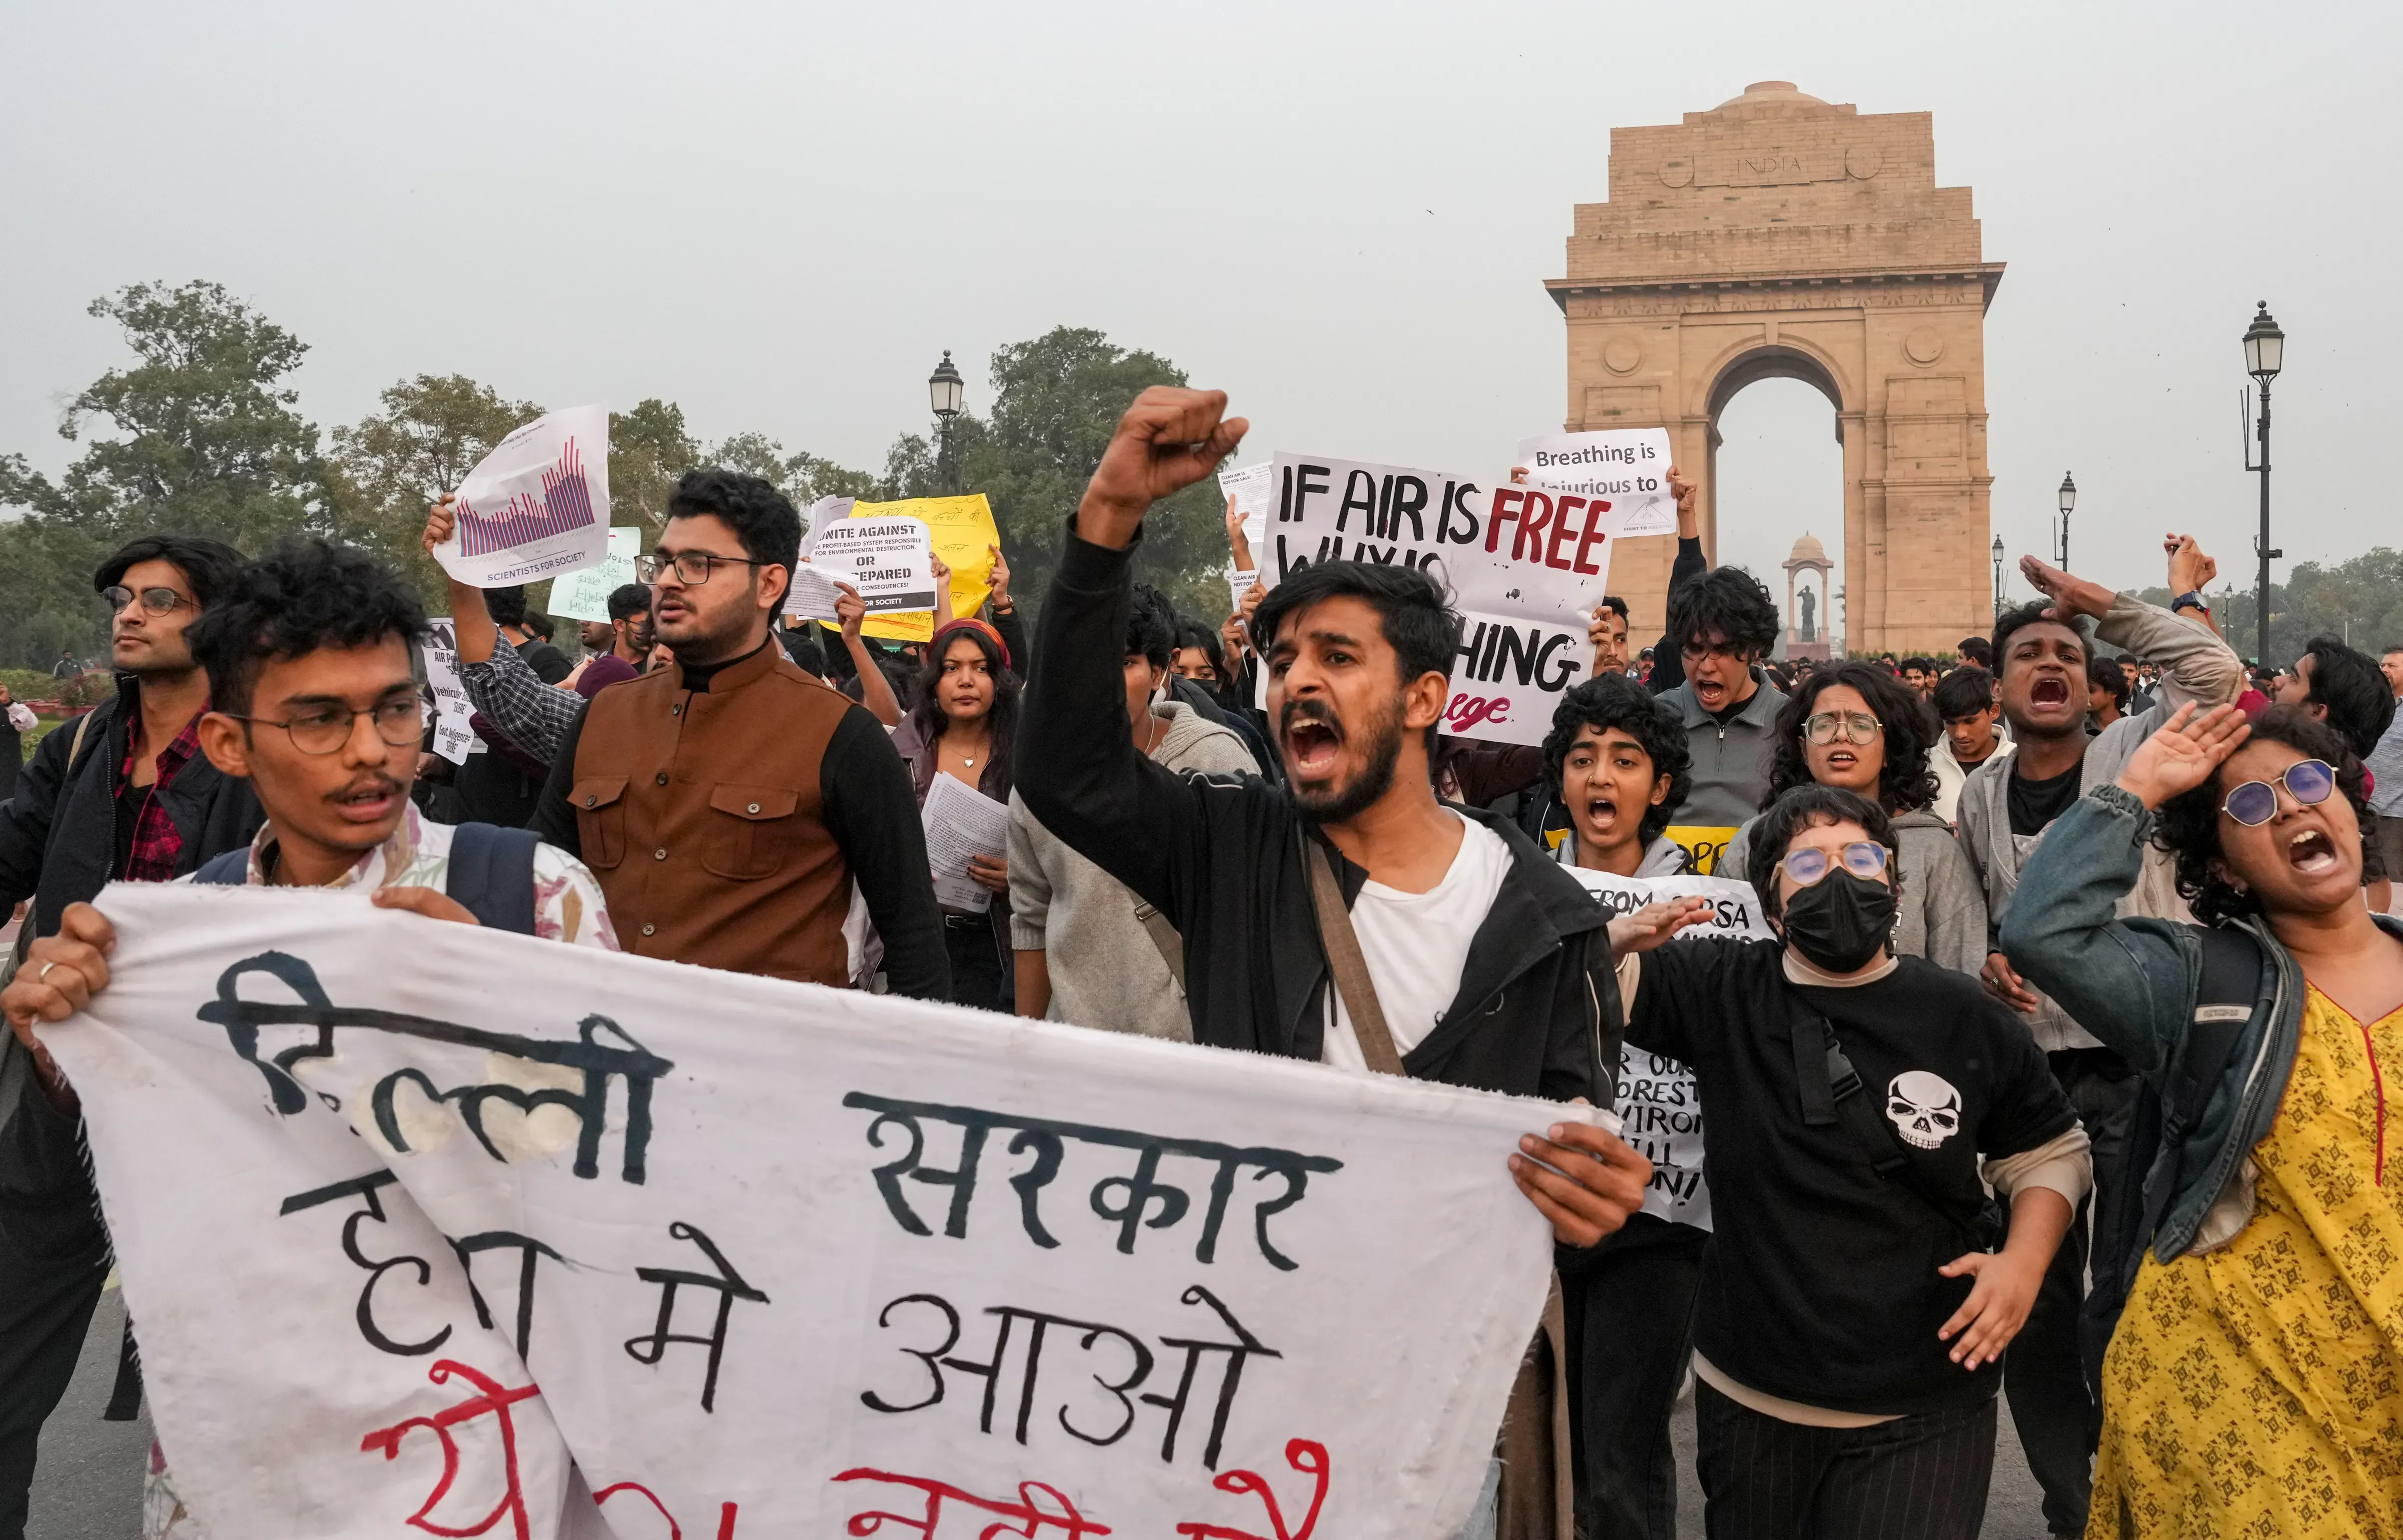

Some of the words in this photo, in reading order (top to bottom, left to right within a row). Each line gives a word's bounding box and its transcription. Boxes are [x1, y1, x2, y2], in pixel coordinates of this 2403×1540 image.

[1737, 157, 1801, 173] INDIA
[1536, 445, 1636, 466] Breathing
[1640, 442, 1656, 459] is
[1637, 476, 1658, 492] to
[1278, 464, 1330, 523] IF
[1336, 469, 1429, 542] AIR
[1436, 480, 1482, 545] IS
[1484, 487, 1612, 576] FREE
[859, 525, 916, 538] AGAINST
[829, 547, 874, 555] ENVIRONMENTAL
[488, 564, 540, 581] SCIENTISTS
[540, 560, 555, 571] FOR
[555, 551, 586, 567] SOCIETY
[856, 556, 875, 566] OR
[851, 568, 911, 582] EPARED
[862, 583, 909, 591] CONSEQUENCES!
[435, 651, 445, 663] AIR
[1456, 616, 1581, 693] HING
[842, 1090, 1345, 1271] सरकार
[625, 1221, 771, 1413] मे
[860, 1284, 1285, 1472] आओ
